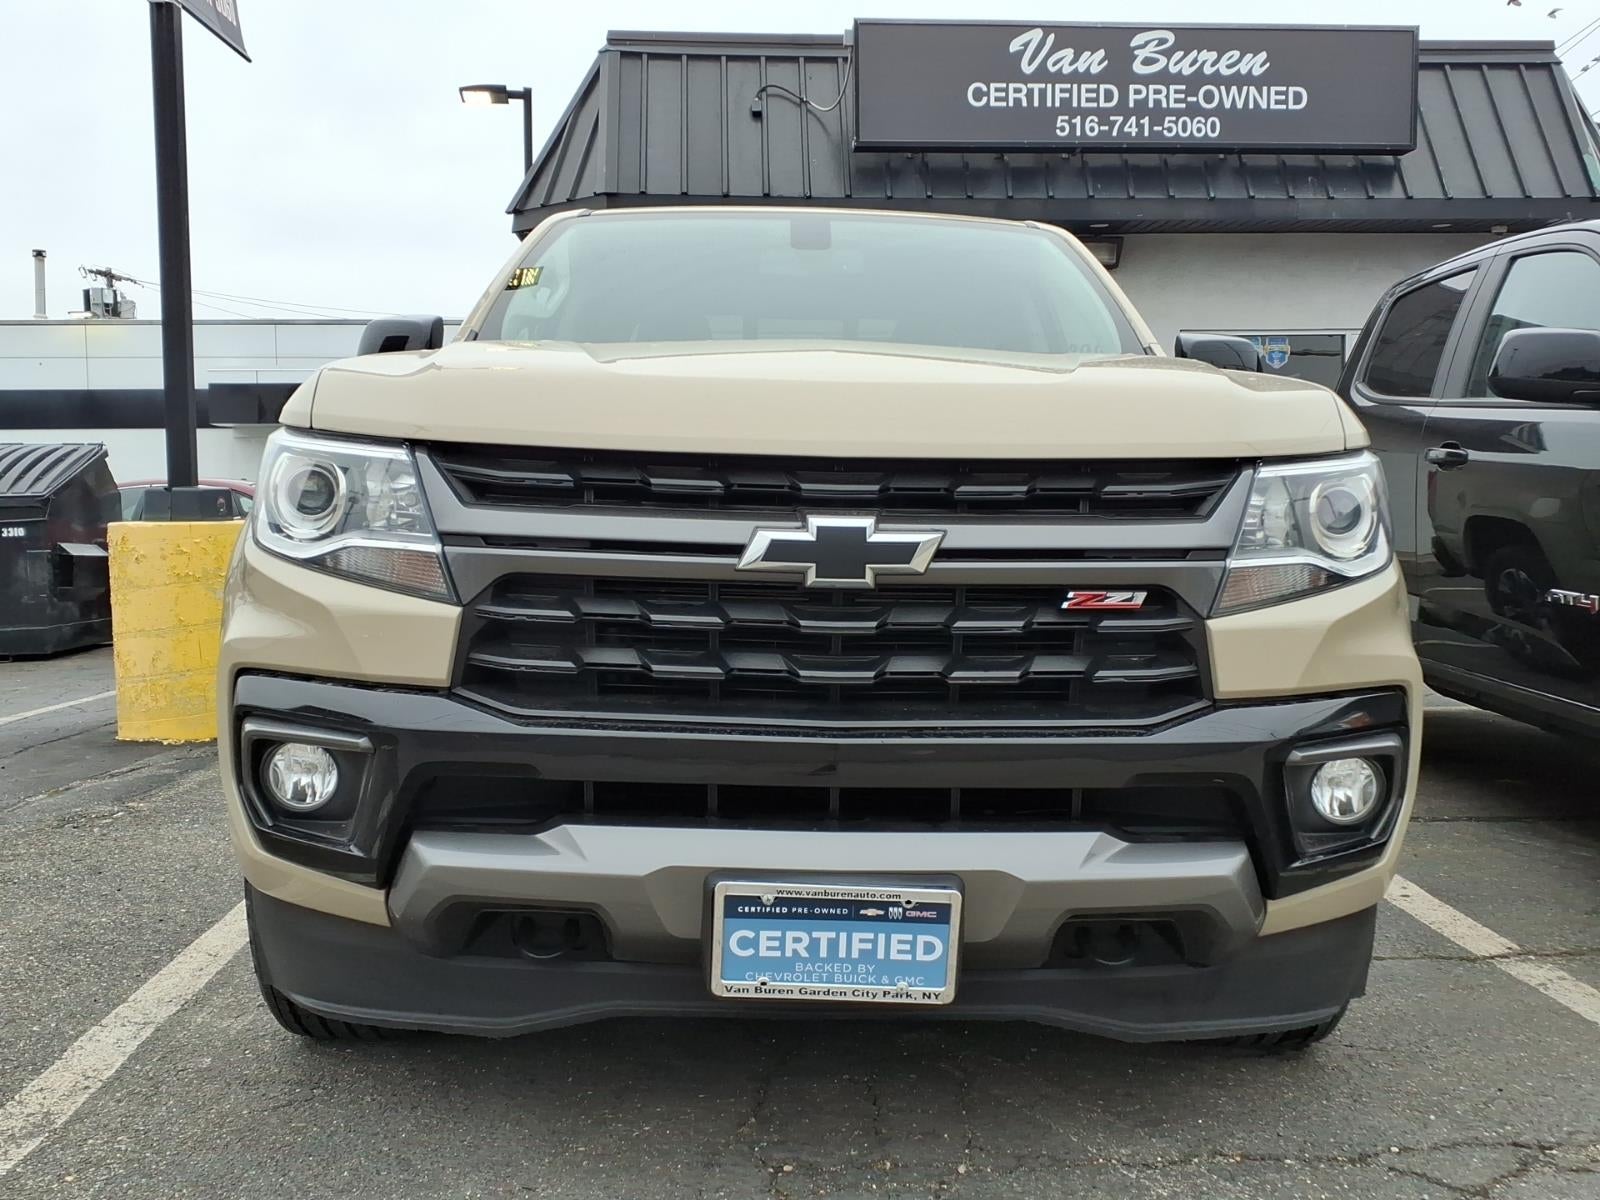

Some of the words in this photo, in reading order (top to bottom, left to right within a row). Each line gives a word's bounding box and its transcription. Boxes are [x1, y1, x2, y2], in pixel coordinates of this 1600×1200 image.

[1009, 27, 1109, 75] Van
[1129, 29, 1271, 77] Buren
[966, 81, 1120, 108] CERTIFIED
[1128, 84, 1309, 111] PRE-OWNED
[1055, 114, 1222, 138] 516-741-5060
[775, 887, 902, 900] www.vanburenauto.com
[737, 905, 788, 914] CERTIFIED
[791, 906, 849, 915] PRE-OWNED
[905, 910, 938, 918] GMC
[728, 929, 944, 962] CERTIFIED
[795, 962, 852, 973] BACKED
[857, 963, 876, 974] BY
[744, 971, 829, 983] CHEVROLET
[834, 973, 877, 984] BUICK
[880, 975, 890, 985] &
[894, 975, 925, 986] GMC
[724, 985, 750, 995] Van
[754, 986, 794, 996] Buren
[798, 987, 847, 997] Garden
[851, 988, 878, 999] City
[882, 990, 918, 1001] Park,
[921, 991, 942, 1000] NY
